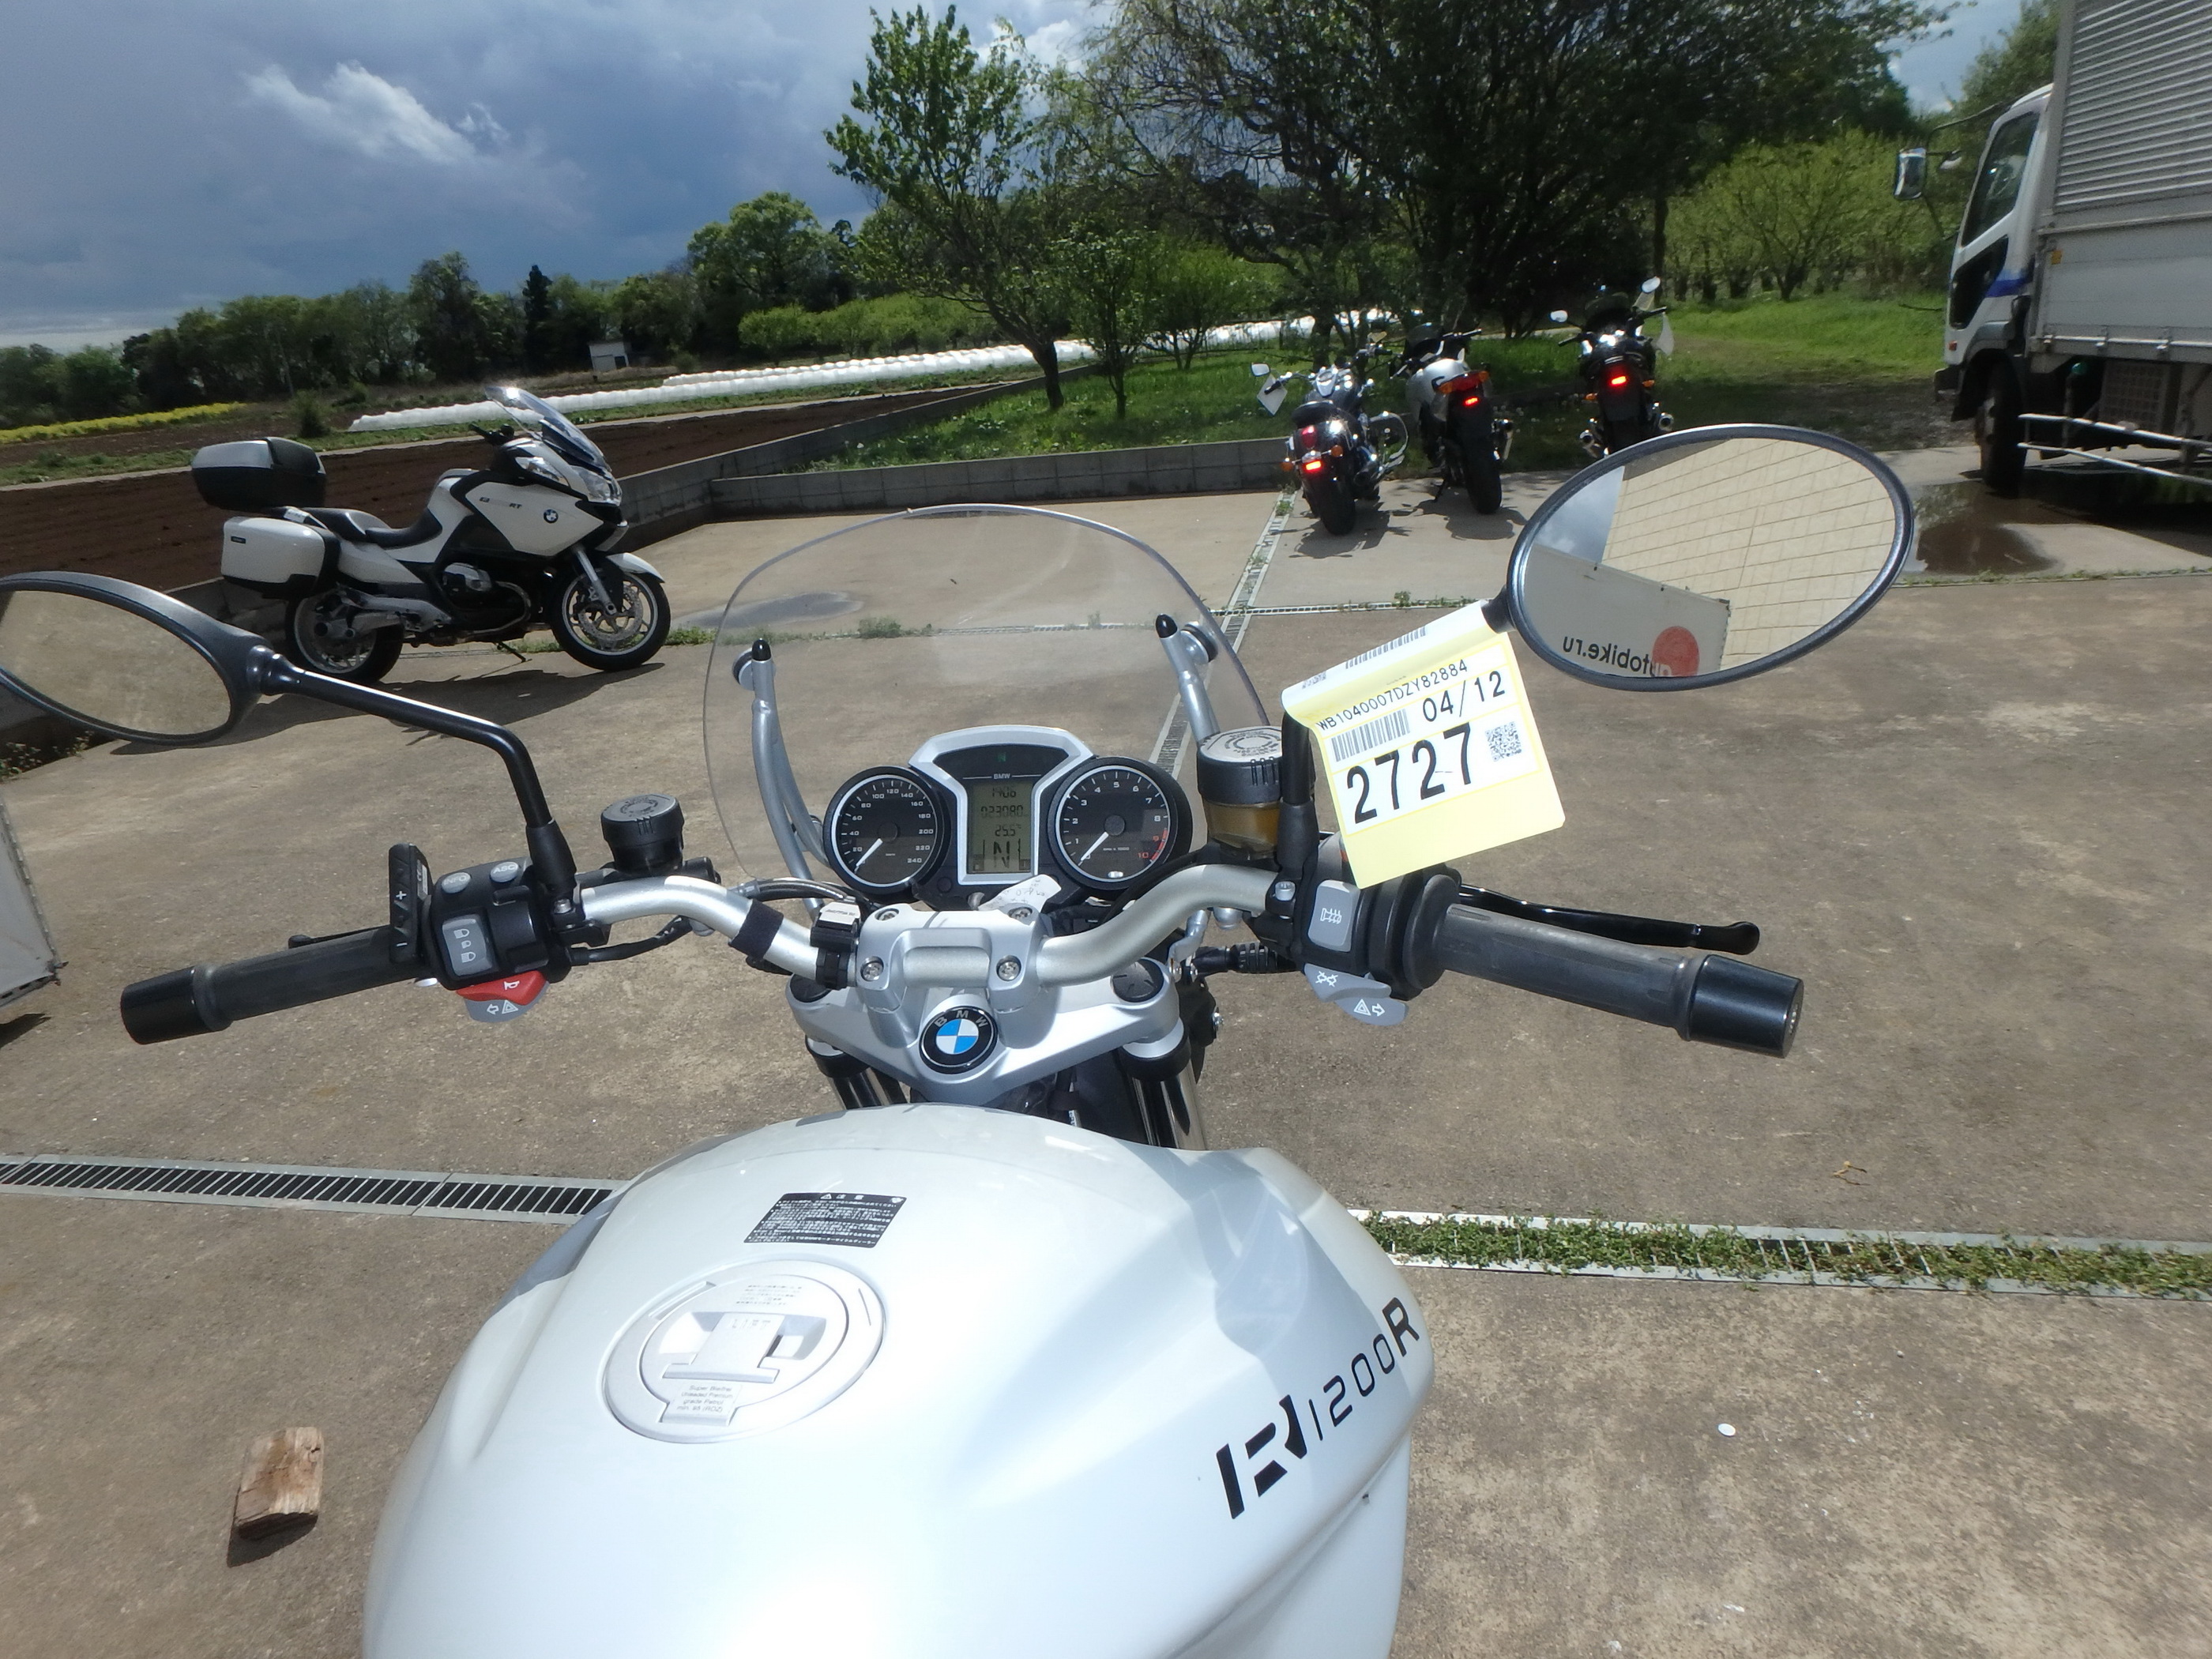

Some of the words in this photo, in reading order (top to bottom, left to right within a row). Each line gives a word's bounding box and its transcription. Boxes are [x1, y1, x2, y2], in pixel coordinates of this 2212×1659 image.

[1317, 659, 1468, 732] WB1040007DZY82884
[1422, 670, 1506, 723] 04/12
[1347, 722, 1471, 824] 2727
[444, 875, 467, 885] INFO
[493, 864, 516, 875] ASC
[934, 1010, 988, 1028] BMW
